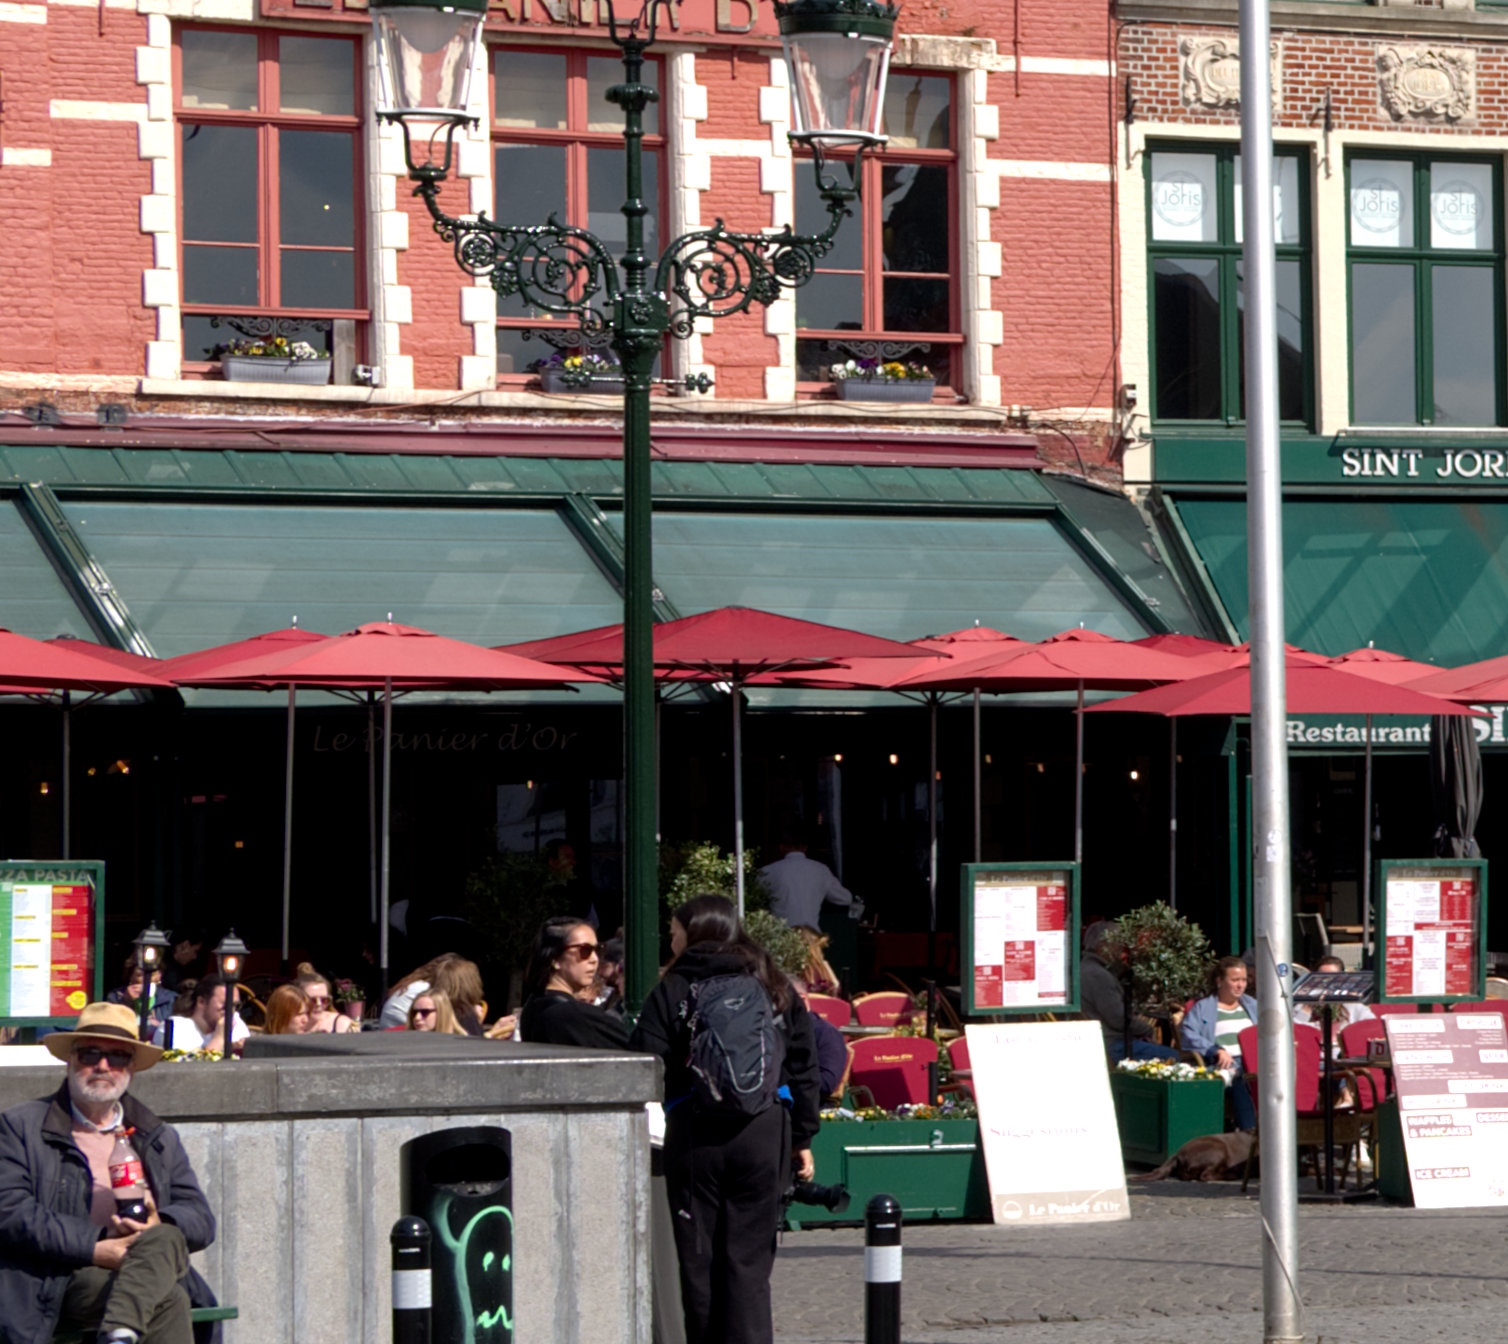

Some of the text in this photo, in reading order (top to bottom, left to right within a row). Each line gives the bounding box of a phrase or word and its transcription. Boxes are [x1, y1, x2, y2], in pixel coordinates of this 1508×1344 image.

[1341, 447, 1424, 478] SINT
[312, 721, 578, 752] Le Panier d'Or
[1286, 719, 1433, 744] Restaurant
[1407, 1115, 1452, 1126] WAFFLES
[1419, 1126, 1471, 1138] PANCAKES
[1416, 1169, 1433, 1180] ICE
[1028, 1203, 1046, 1217] Le
